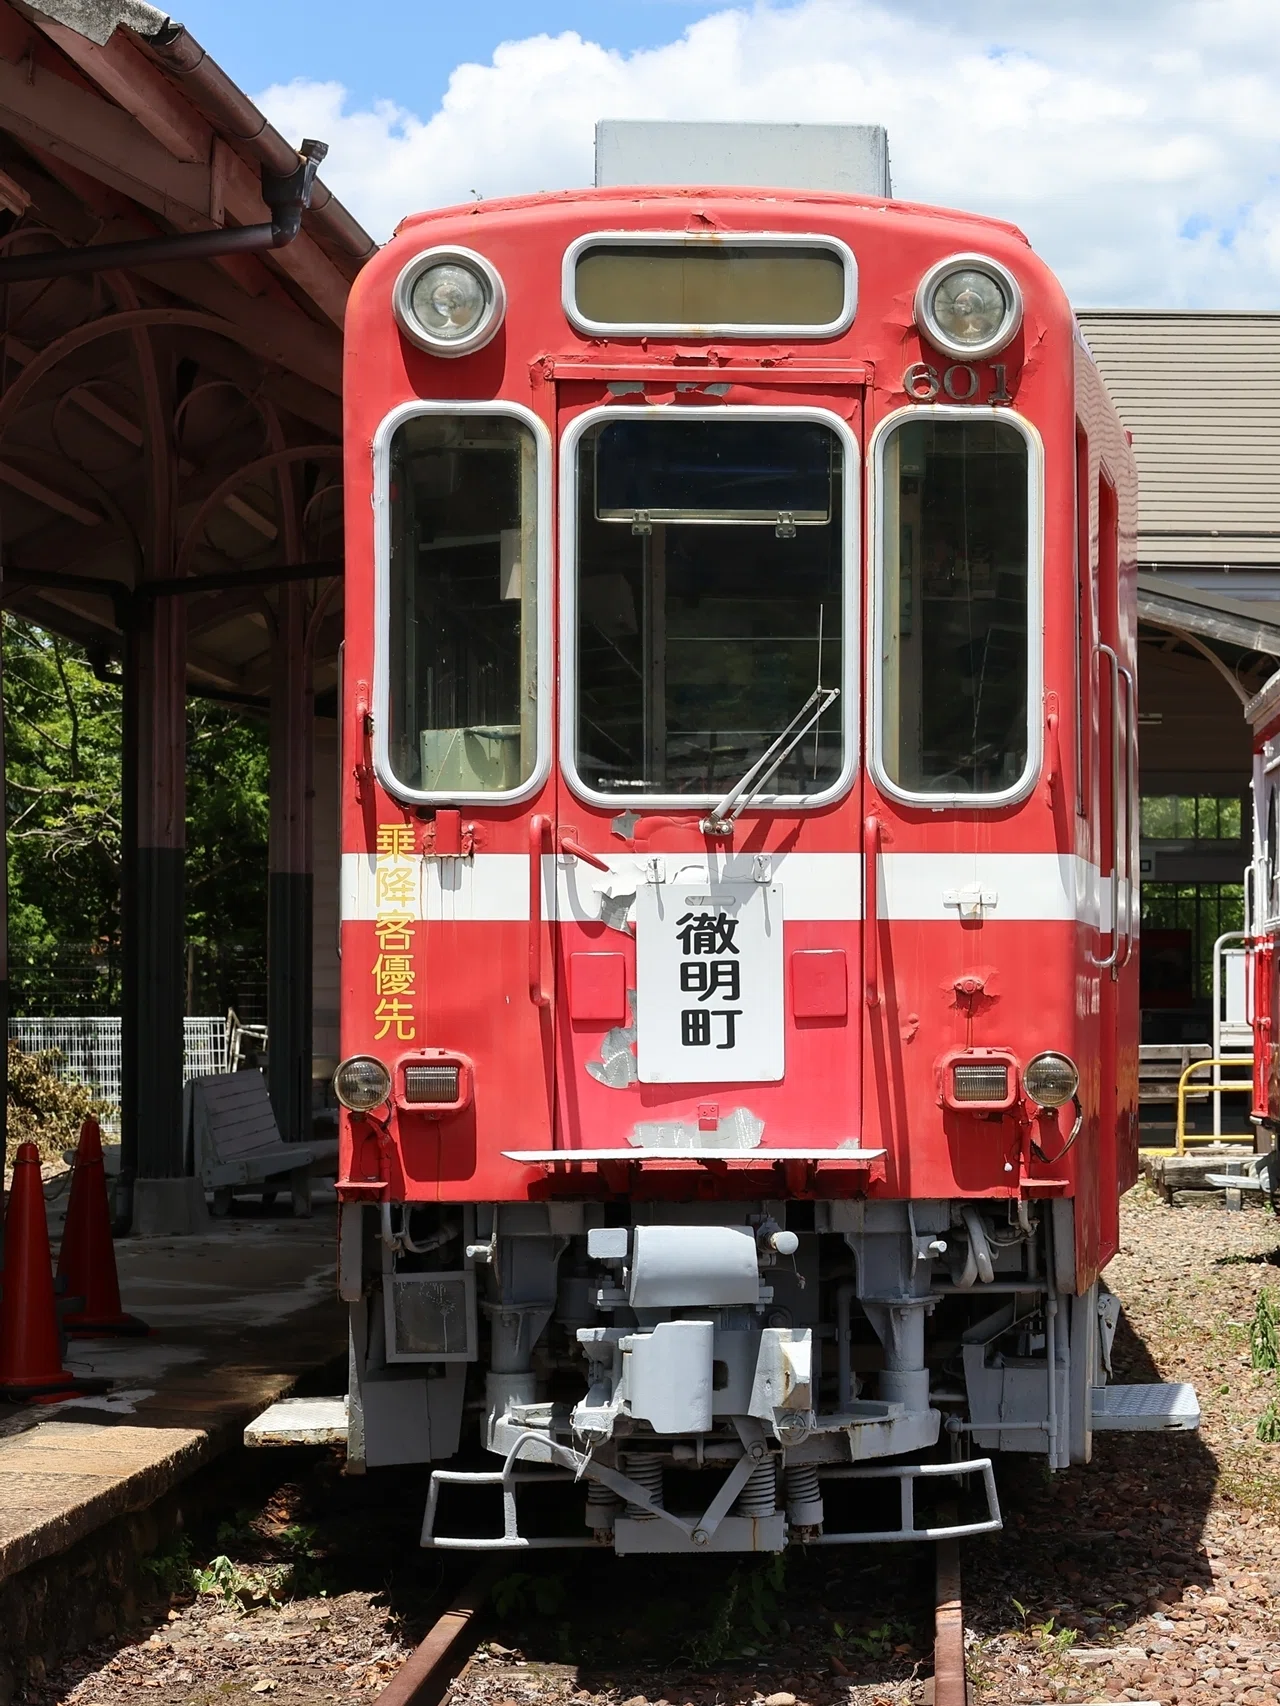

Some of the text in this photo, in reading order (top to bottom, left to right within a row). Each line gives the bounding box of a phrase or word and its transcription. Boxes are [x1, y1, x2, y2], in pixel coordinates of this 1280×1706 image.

[903, 362, 1012, 402] 601
[371, 823, 416, 1040] 乗降客優先
[675, 912, 743, 1050] 徹明町
